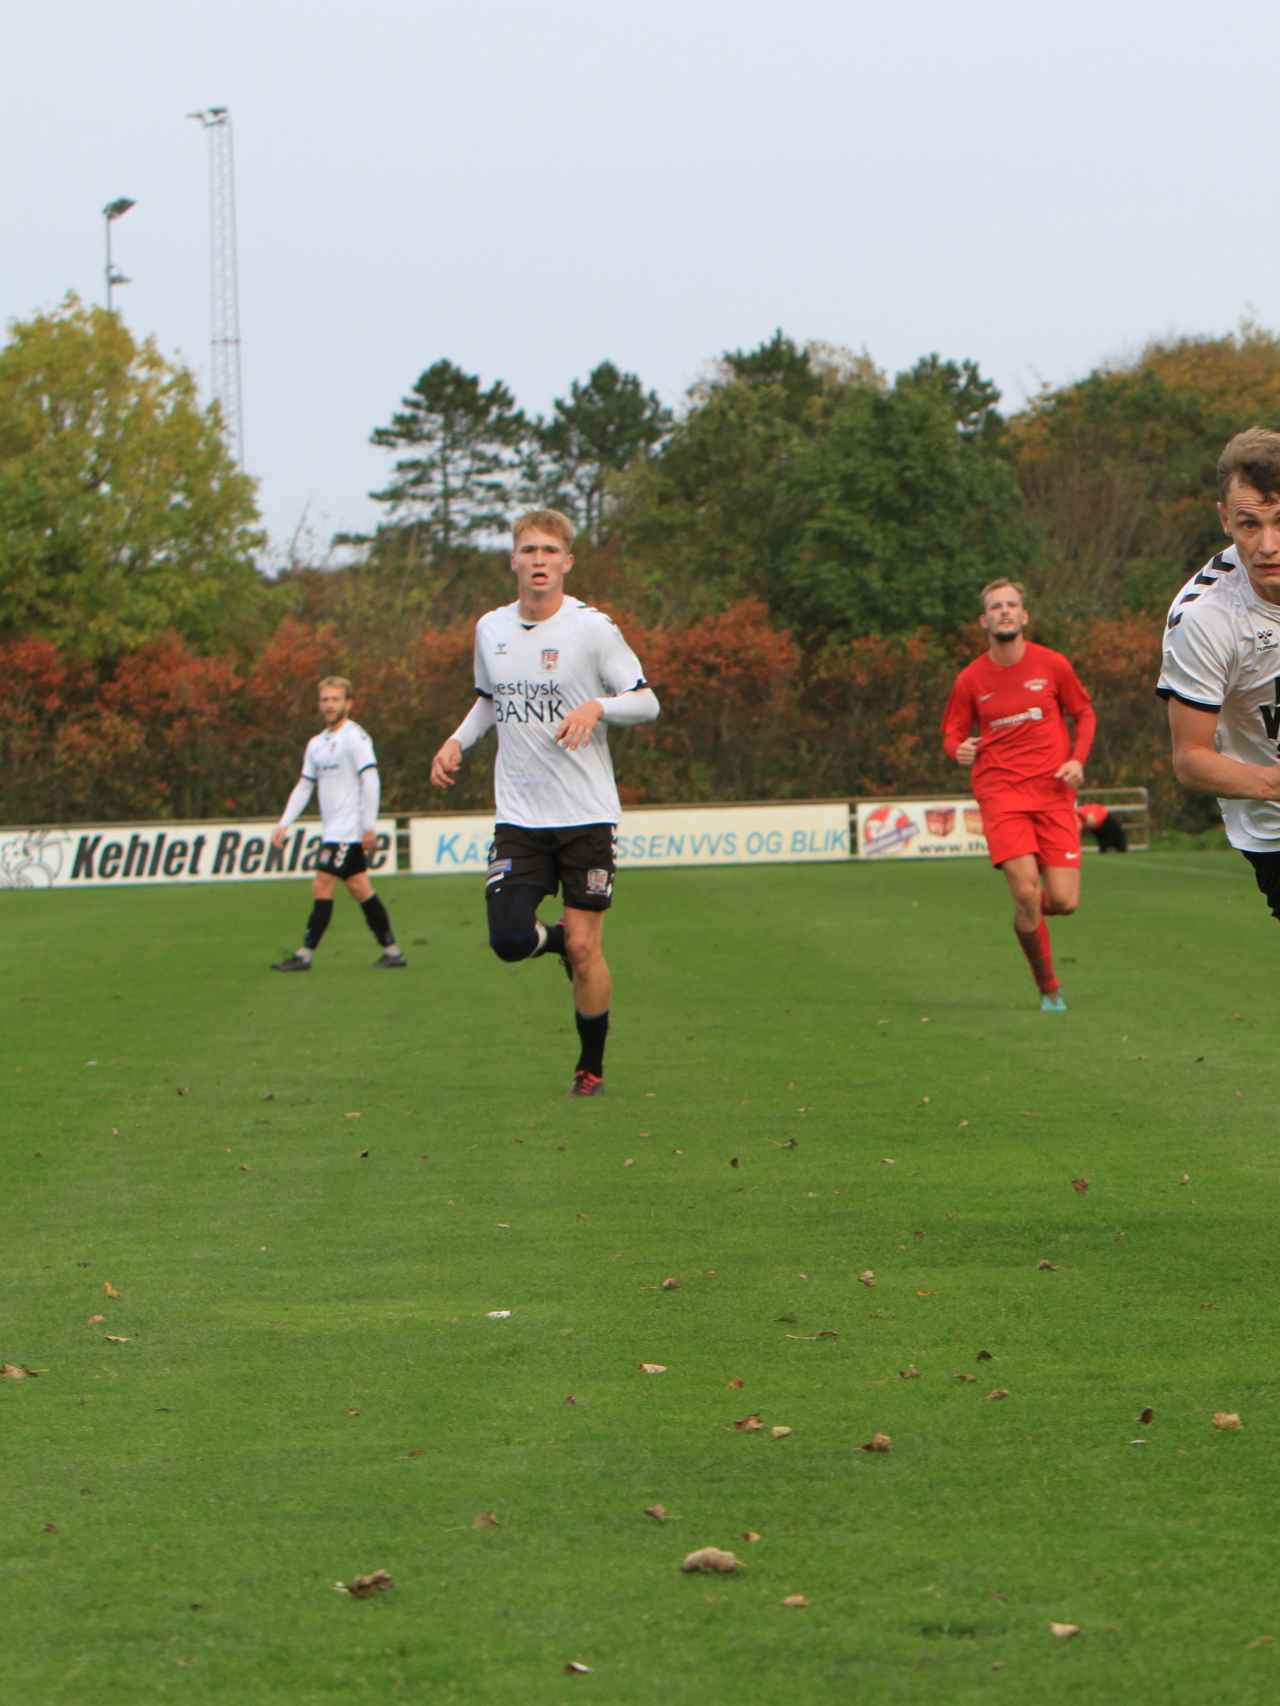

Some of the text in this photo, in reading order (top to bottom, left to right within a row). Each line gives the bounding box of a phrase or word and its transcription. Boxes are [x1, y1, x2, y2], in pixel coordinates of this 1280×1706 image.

[495, 680, 561, 700] estjysk
[70, 828, 391, 879] Kehlet Reklae
[689, 831, 737, 856] VVS
[745, 831, 784, 855] OG
[790, 828, 847, 853] BLIK
